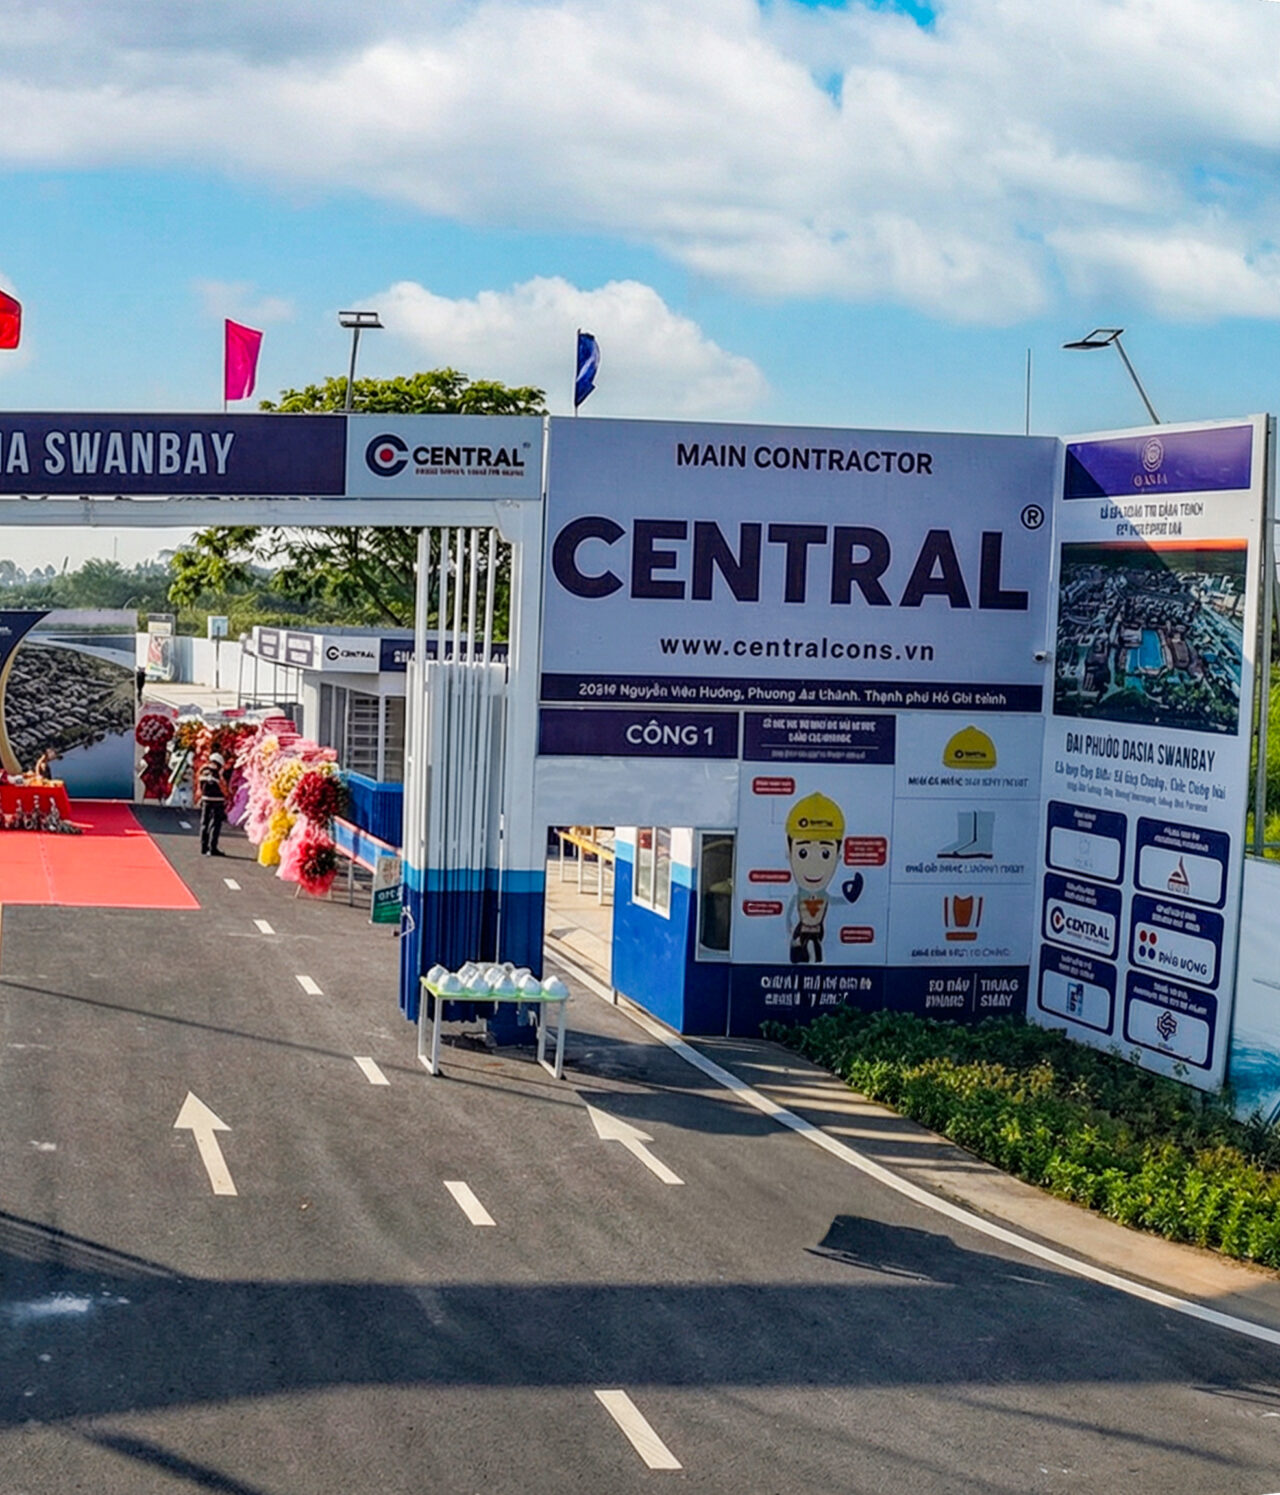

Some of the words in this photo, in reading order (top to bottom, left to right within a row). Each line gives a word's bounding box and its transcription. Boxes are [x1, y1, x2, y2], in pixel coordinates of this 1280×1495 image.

[44, 431, 235, 475] SWANBAY
[412, 446, 525, 467] CENTRAL
[676, 443, 747, 468] MAIN
[753, 446, 933, 474] CONTRACTOR
[551, 515, 1029, 611] CENTRAL
[659, 637, 935, 661] www.centralcons.vn
[703, 726, 714, 746] 1
[1157, 743, 1216, 773] SWANBAY
[1065, 916, 1110, 941] CENTRAL
